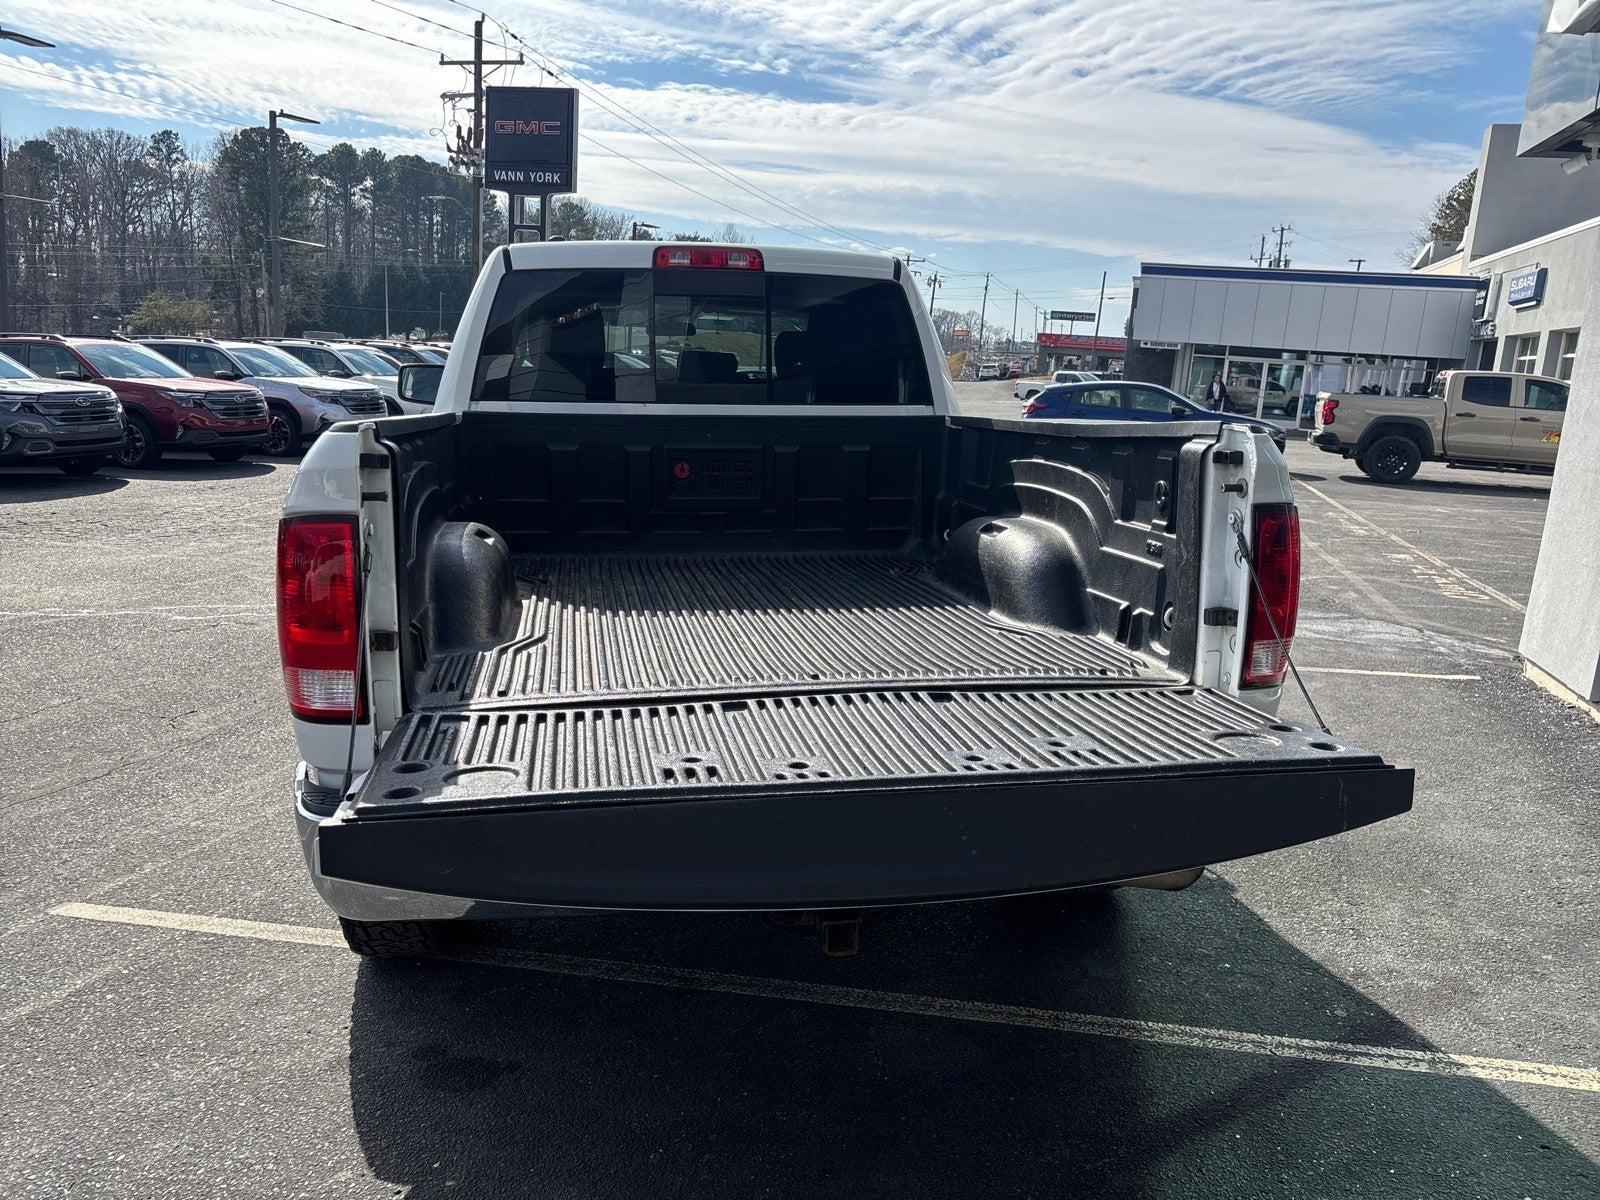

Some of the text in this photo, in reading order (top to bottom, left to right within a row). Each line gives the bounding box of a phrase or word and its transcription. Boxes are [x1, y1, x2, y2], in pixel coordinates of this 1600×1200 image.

[495, 121, 560, 135] GMC
[494, 170, 561, 183] VANN YORK
[1511, 275, 1537, 291] SUBARU
[1052, 312, 1095, 320] enterprise
